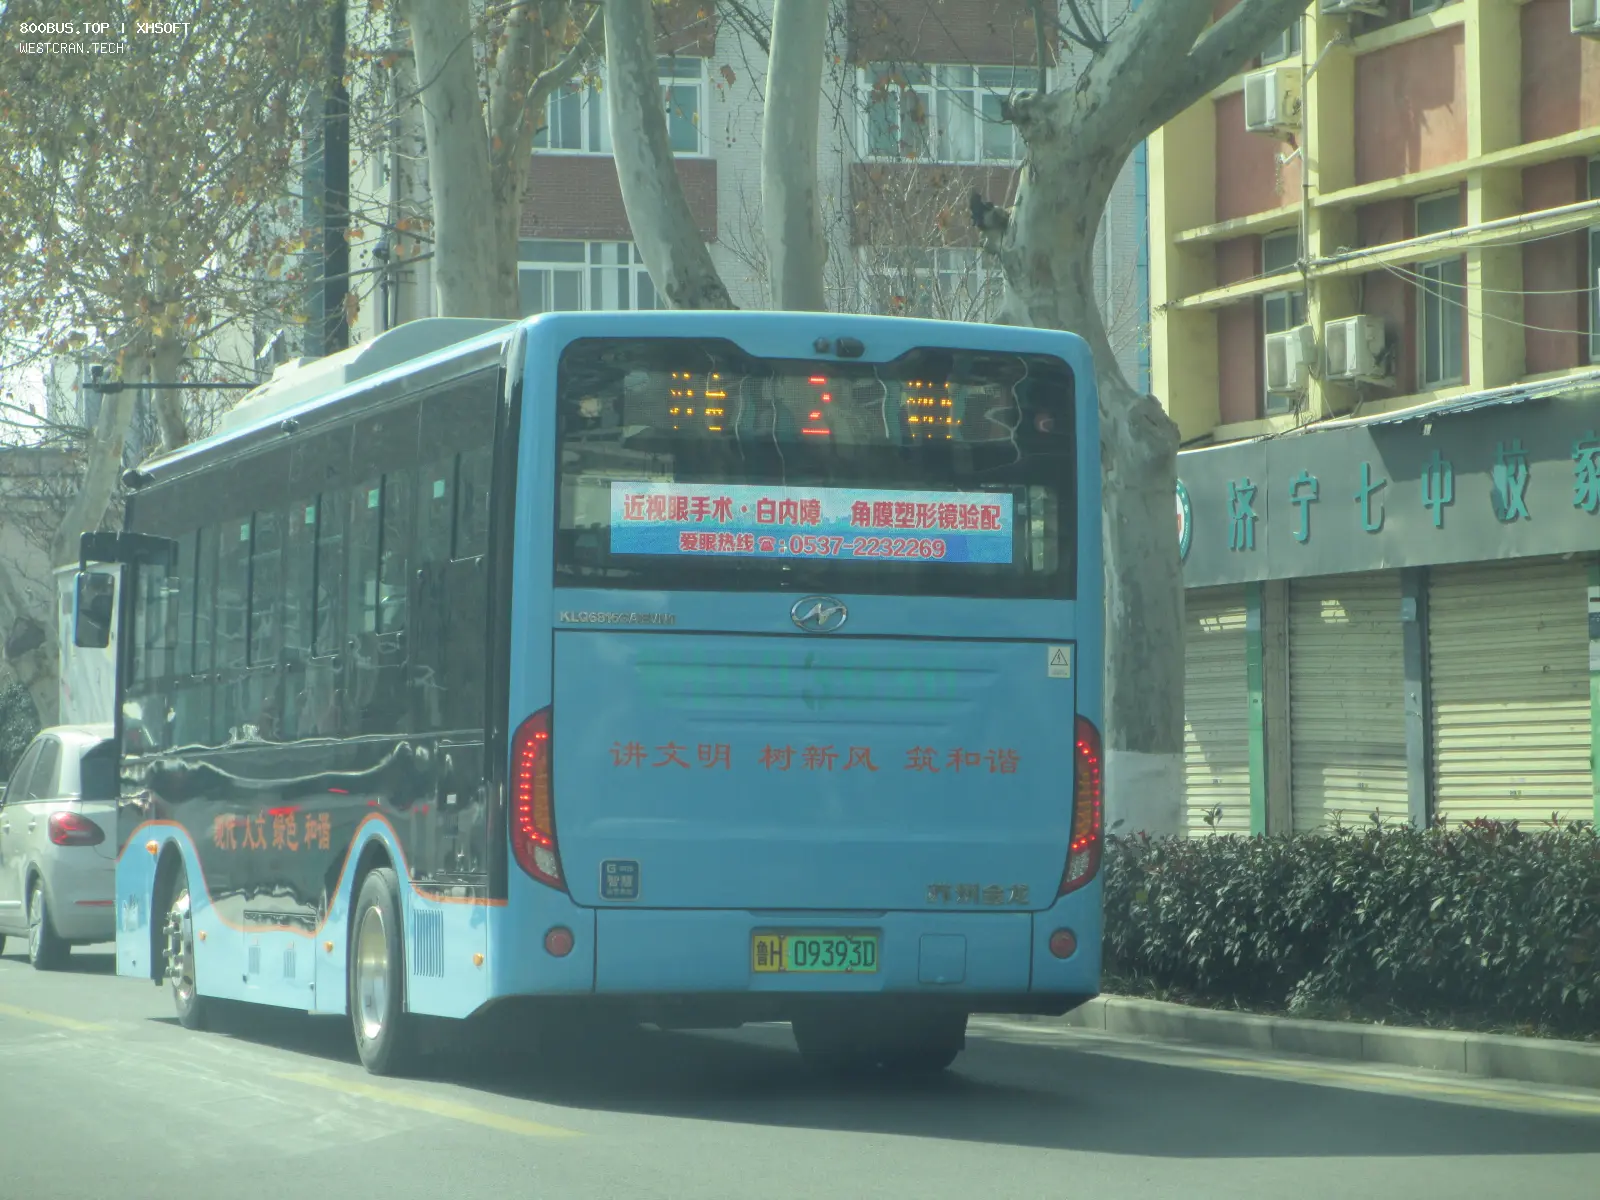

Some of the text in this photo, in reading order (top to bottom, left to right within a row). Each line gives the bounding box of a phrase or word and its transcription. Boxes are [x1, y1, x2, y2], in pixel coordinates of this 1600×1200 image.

[851, 500, 1002, 531] 角膜塑形镜验配
[679, 531, 754, 553] 爱眼热线
[609, 741, 1021, 774] 讲文明 树新风 筑和谐
[242, 811, 268, 850] 人文
[304, 812, 332, 850] 和谐
